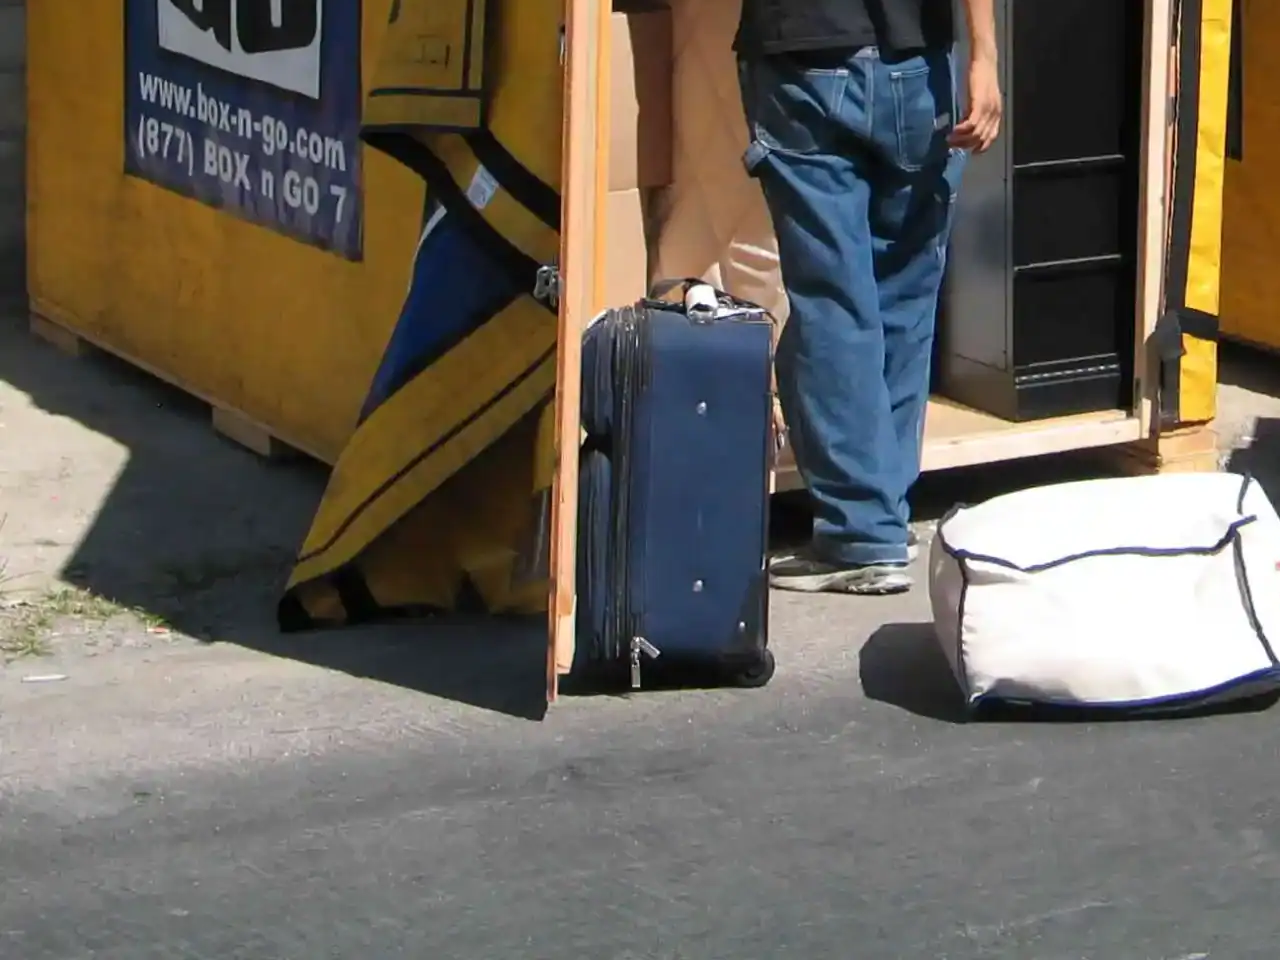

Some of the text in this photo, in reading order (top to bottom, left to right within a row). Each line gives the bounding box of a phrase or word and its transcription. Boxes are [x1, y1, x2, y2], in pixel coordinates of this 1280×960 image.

[137, 114, 348, 224] (877) BOX n GO 7
[139, 71, 346, 172] www.box-n-go.com
